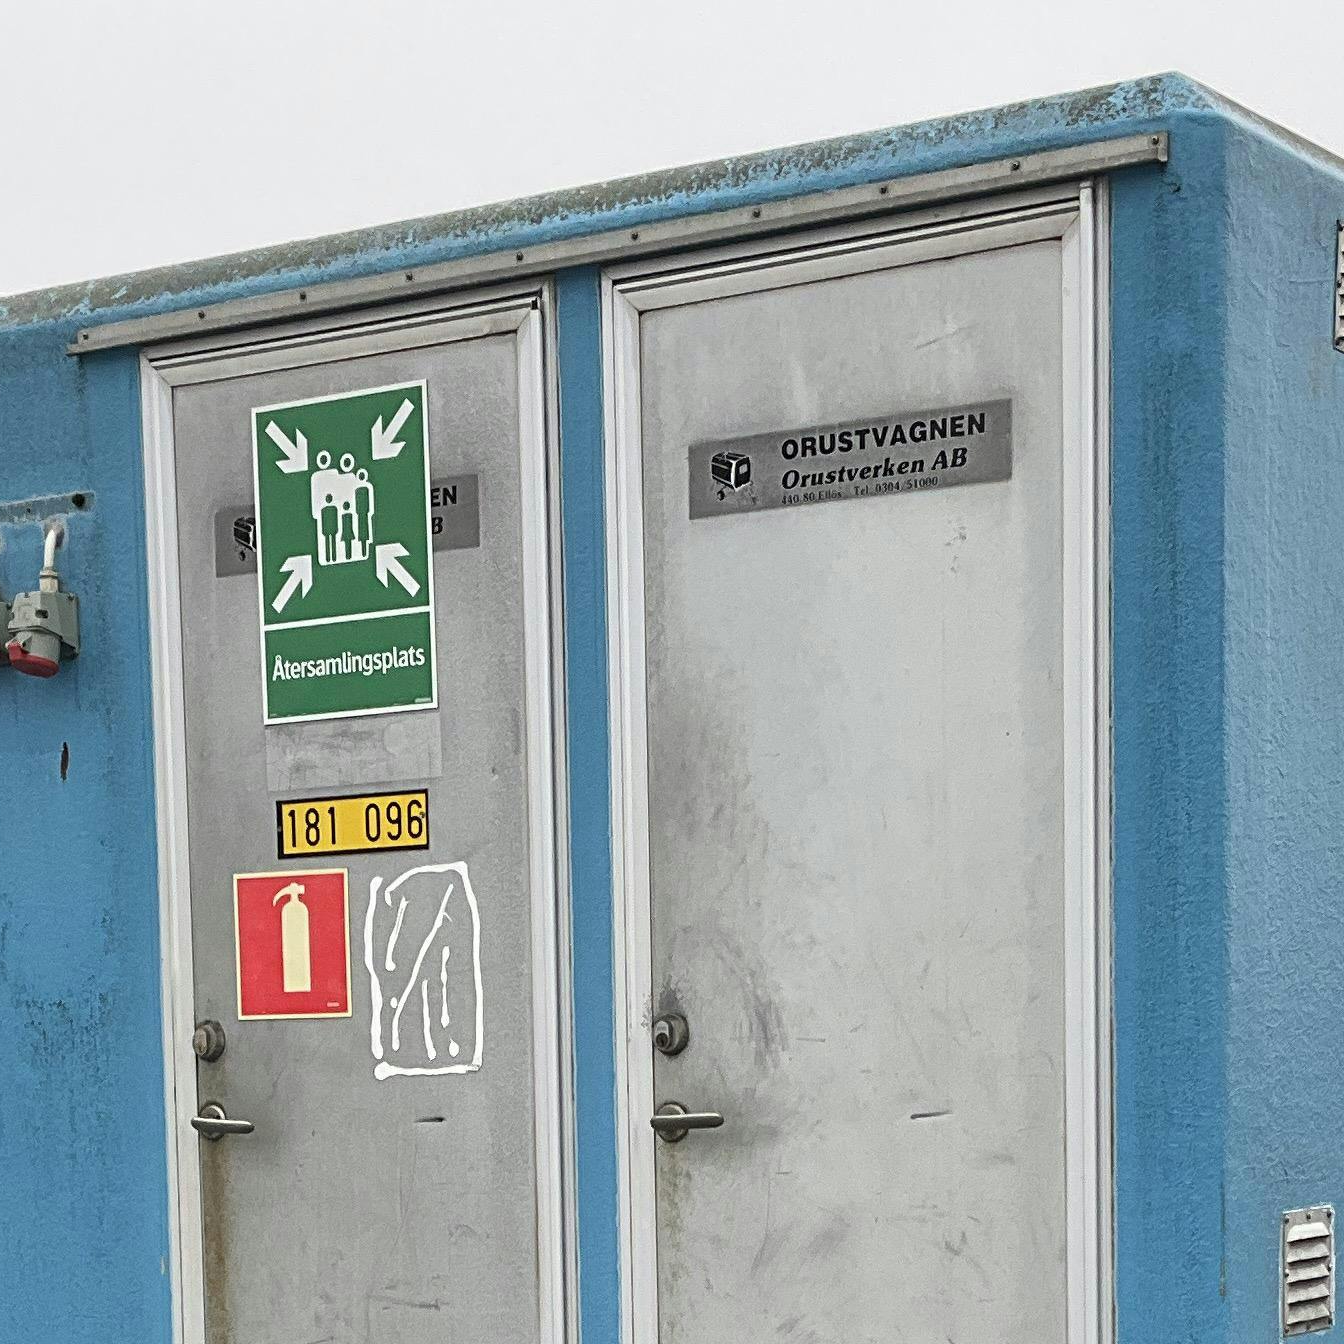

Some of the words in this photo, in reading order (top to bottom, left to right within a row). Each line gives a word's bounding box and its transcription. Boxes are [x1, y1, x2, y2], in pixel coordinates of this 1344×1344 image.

[781, 412, 986, 460] ORUSTVAGNEN
[781, 457, 925, 490] Orustverken
[931, 447, 968, 471] AB
[431, 485, 458, 508] EN
[272, 646, 426, 681] Återsamlingsplats
[288, 806, 337, 848] 181
[364, 799, 424, 843] 096
